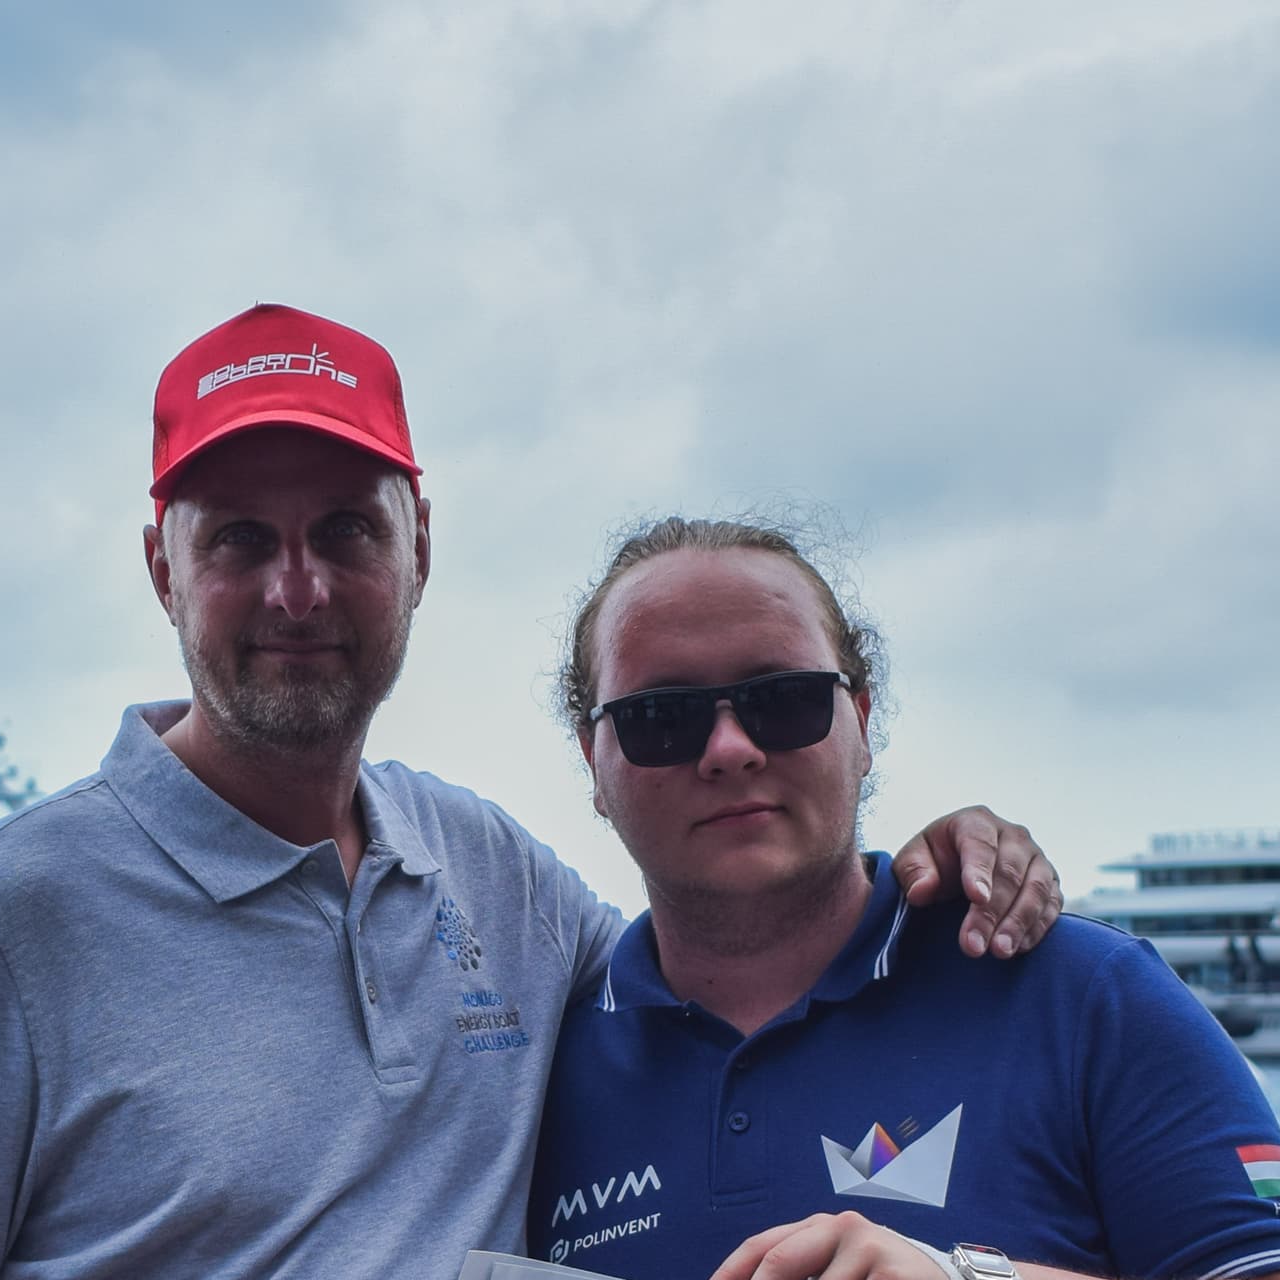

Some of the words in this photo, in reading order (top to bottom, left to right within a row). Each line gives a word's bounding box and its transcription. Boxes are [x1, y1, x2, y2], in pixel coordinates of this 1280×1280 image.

[464, 1031, 529, 1054] CHALLENGE
[552, 1164, 662, 1228] MVM
[574, 1212, 662, 1252] POLINVENT
